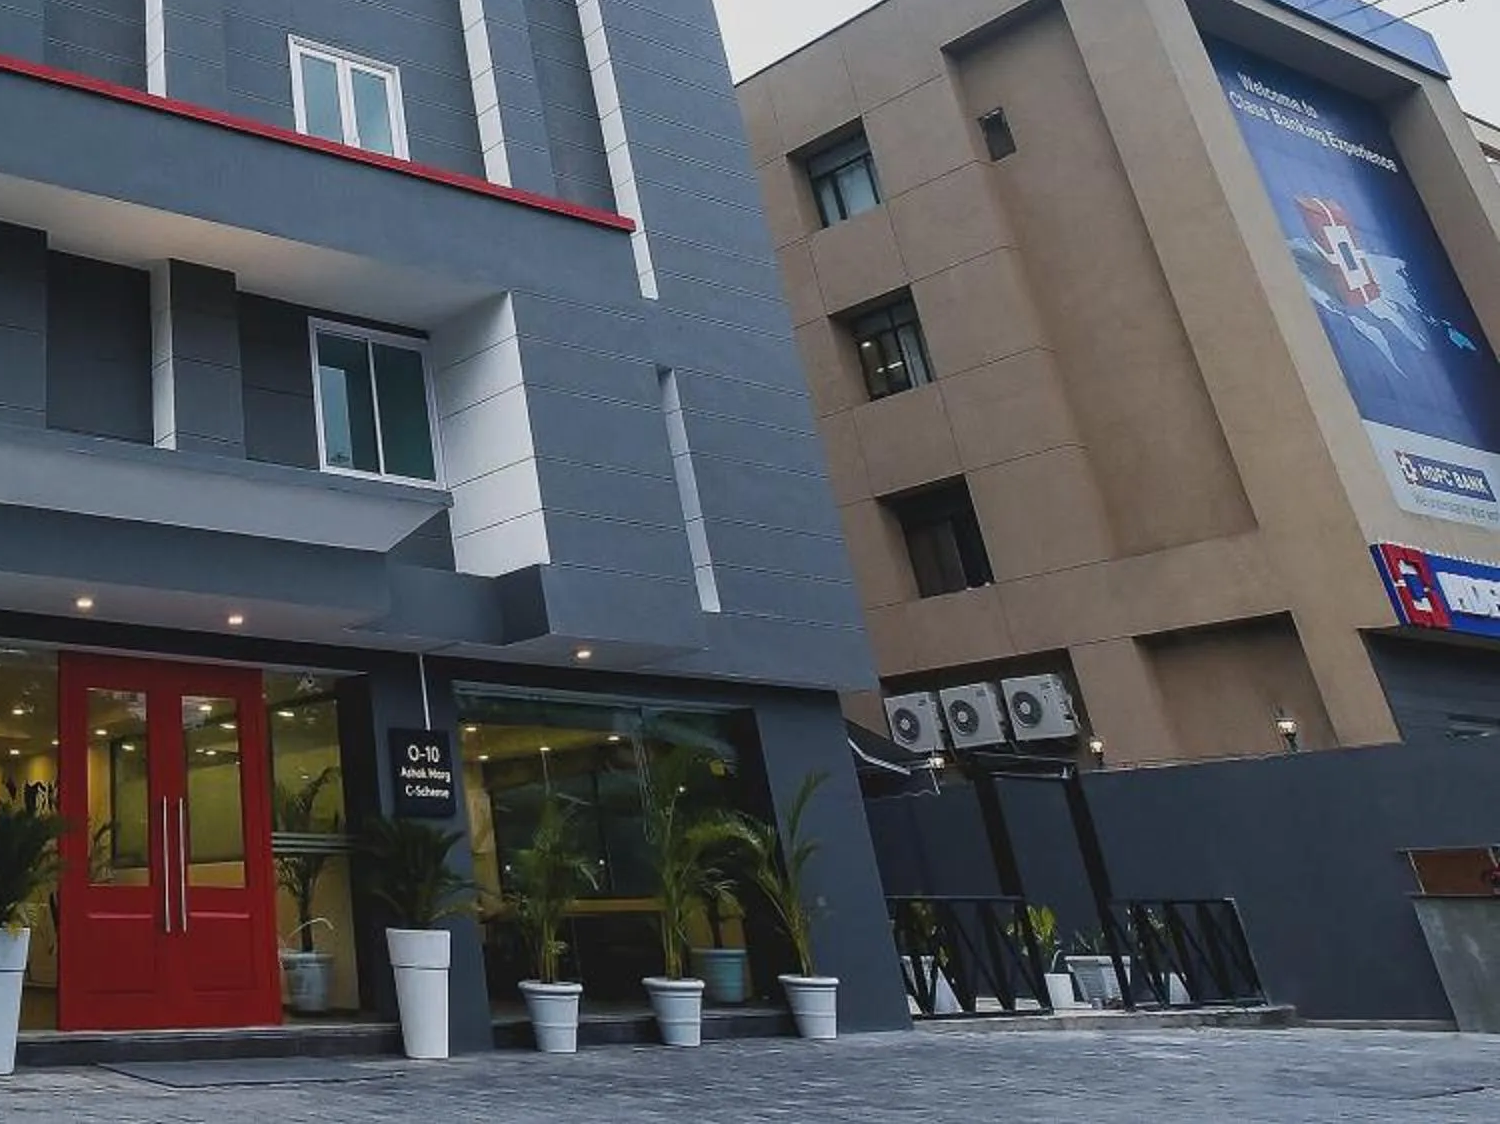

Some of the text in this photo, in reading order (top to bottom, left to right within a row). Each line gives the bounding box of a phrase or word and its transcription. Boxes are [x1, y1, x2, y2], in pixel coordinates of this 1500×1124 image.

[1237, 72, 1302, 112] Welcome
[1270, 107, 1329, 146] Banking
[1419, 464, 1490, 494] HDFC BANK
